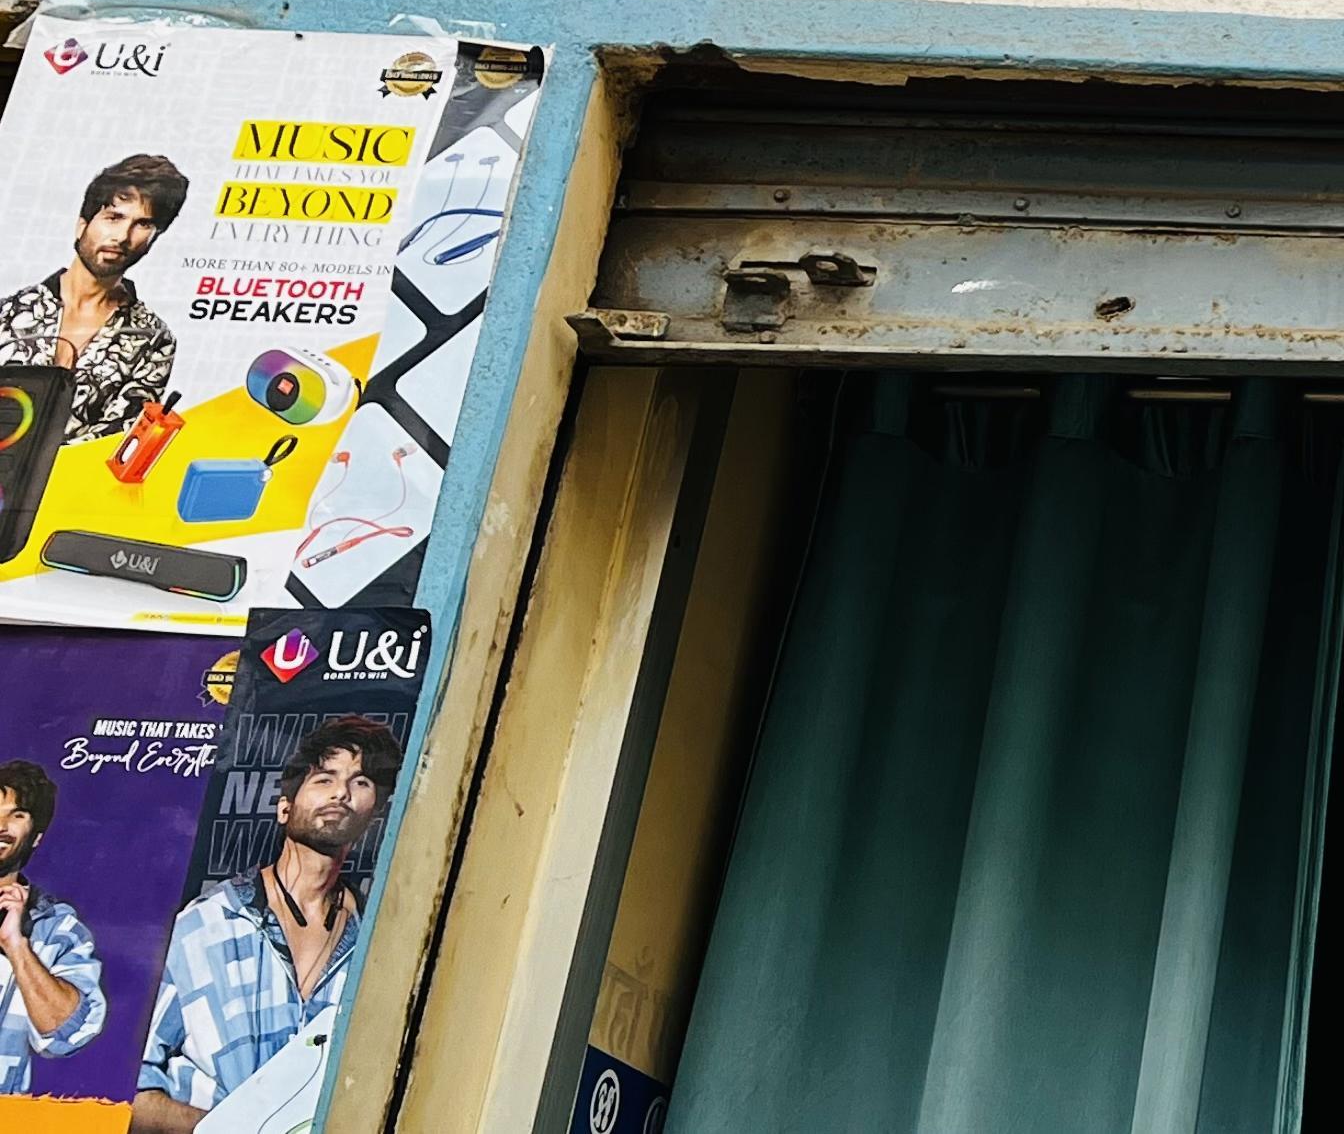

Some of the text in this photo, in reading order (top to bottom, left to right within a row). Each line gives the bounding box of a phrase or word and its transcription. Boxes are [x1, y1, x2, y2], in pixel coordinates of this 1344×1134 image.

[240, 123, 409, 164] MUSIC
[219, 186, 394, 220] BEYOND
[210, 221, 384, 247] EVERYTHING
[182, 258, 227, 270] MORE
[232, 259, 273, 272] THAN
[312, 263, 373, 275] MODELS
[376, 265, 393, 276] IN
[197, 276, 365, 301] BLUETOOTH
[189, 299, 359, 325] SPEAKERS
[328, 628, 424, 679] U&i
[323, 672, 388, 681] BORN TO WIN
[93, 720, 137, 737] MUSIC
[139, 721, 173, 738] THAT
[174, 722, 216, 740] TAKES
[60, 737, 140, 774] Beyond
